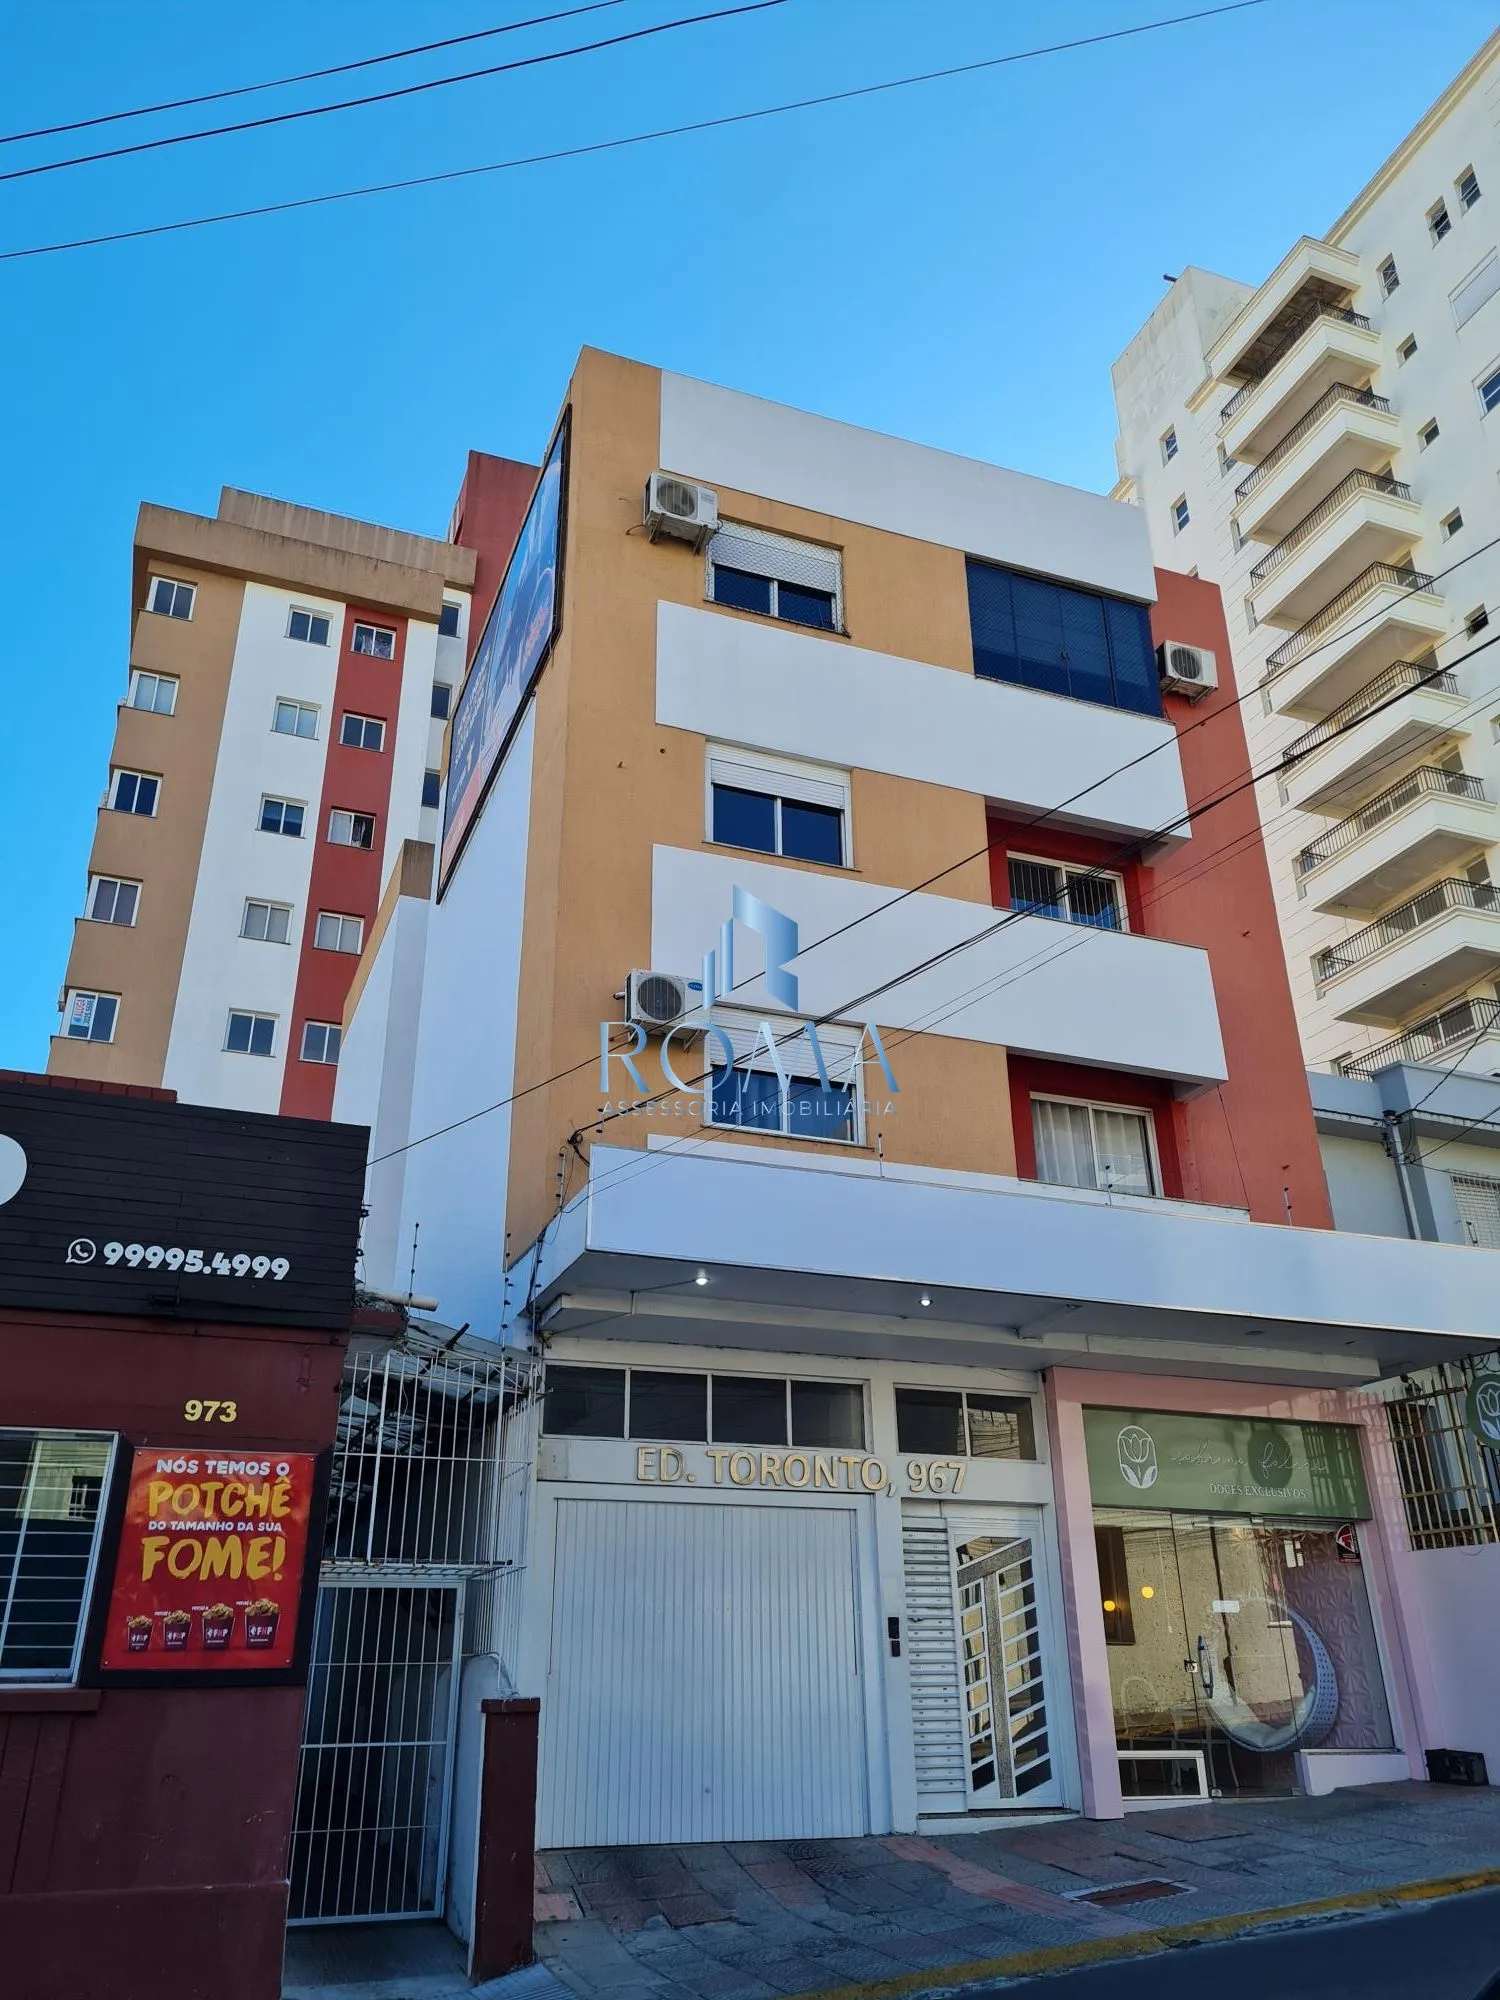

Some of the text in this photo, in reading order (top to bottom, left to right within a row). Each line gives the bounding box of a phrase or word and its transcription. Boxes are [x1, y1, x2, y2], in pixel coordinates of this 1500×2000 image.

[103, 1241, 290, 1281] 99995.4999
[184, 1400, 237, 1423] 973
[156, 1456, 290, 1477] NÓS TEMOS O
[637, 1446, 968, 1498] ED. TORONTO, 967
[148, 1476, 292, 1519] POTCHÊ
[1209, 1482, 1308, 1499] DOCES EXCLUSIVOS
[148, 1520, 282, 1533] DO TAMANHO DA SUA
[142, 1534, 287, 1583] FOME!
